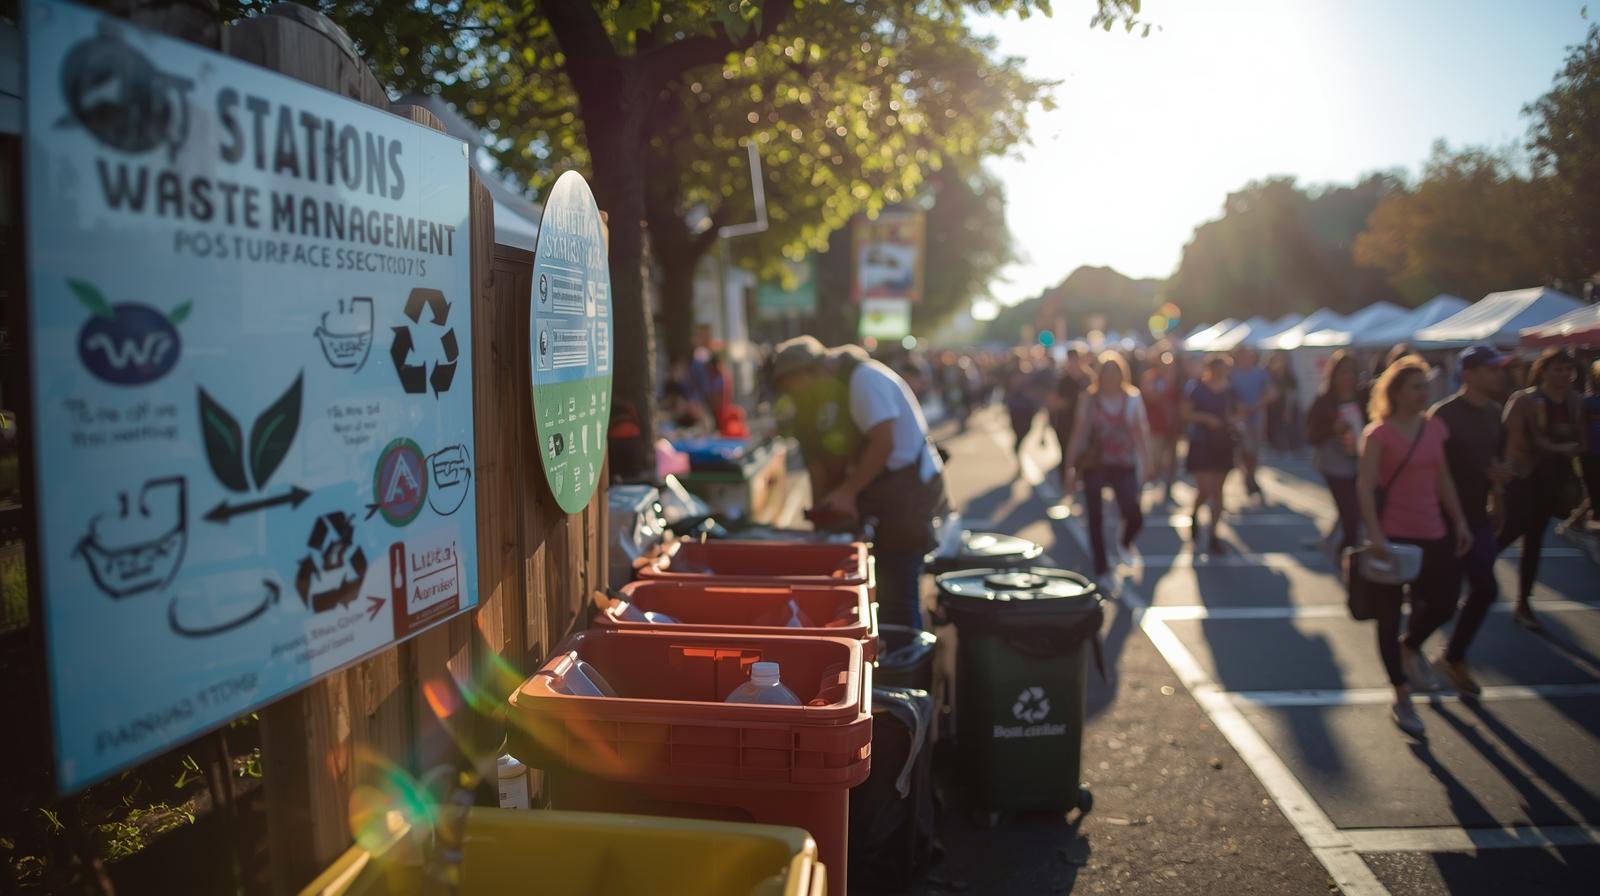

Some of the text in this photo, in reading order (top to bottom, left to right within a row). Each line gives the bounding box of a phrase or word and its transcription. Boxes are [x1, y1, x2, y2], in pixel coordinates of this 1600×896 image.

[216, 87, 406, 201] STATIONS
[96, 159, 260, 230] WASTE
[271, 186, 457, 257] MANAGEMENT
